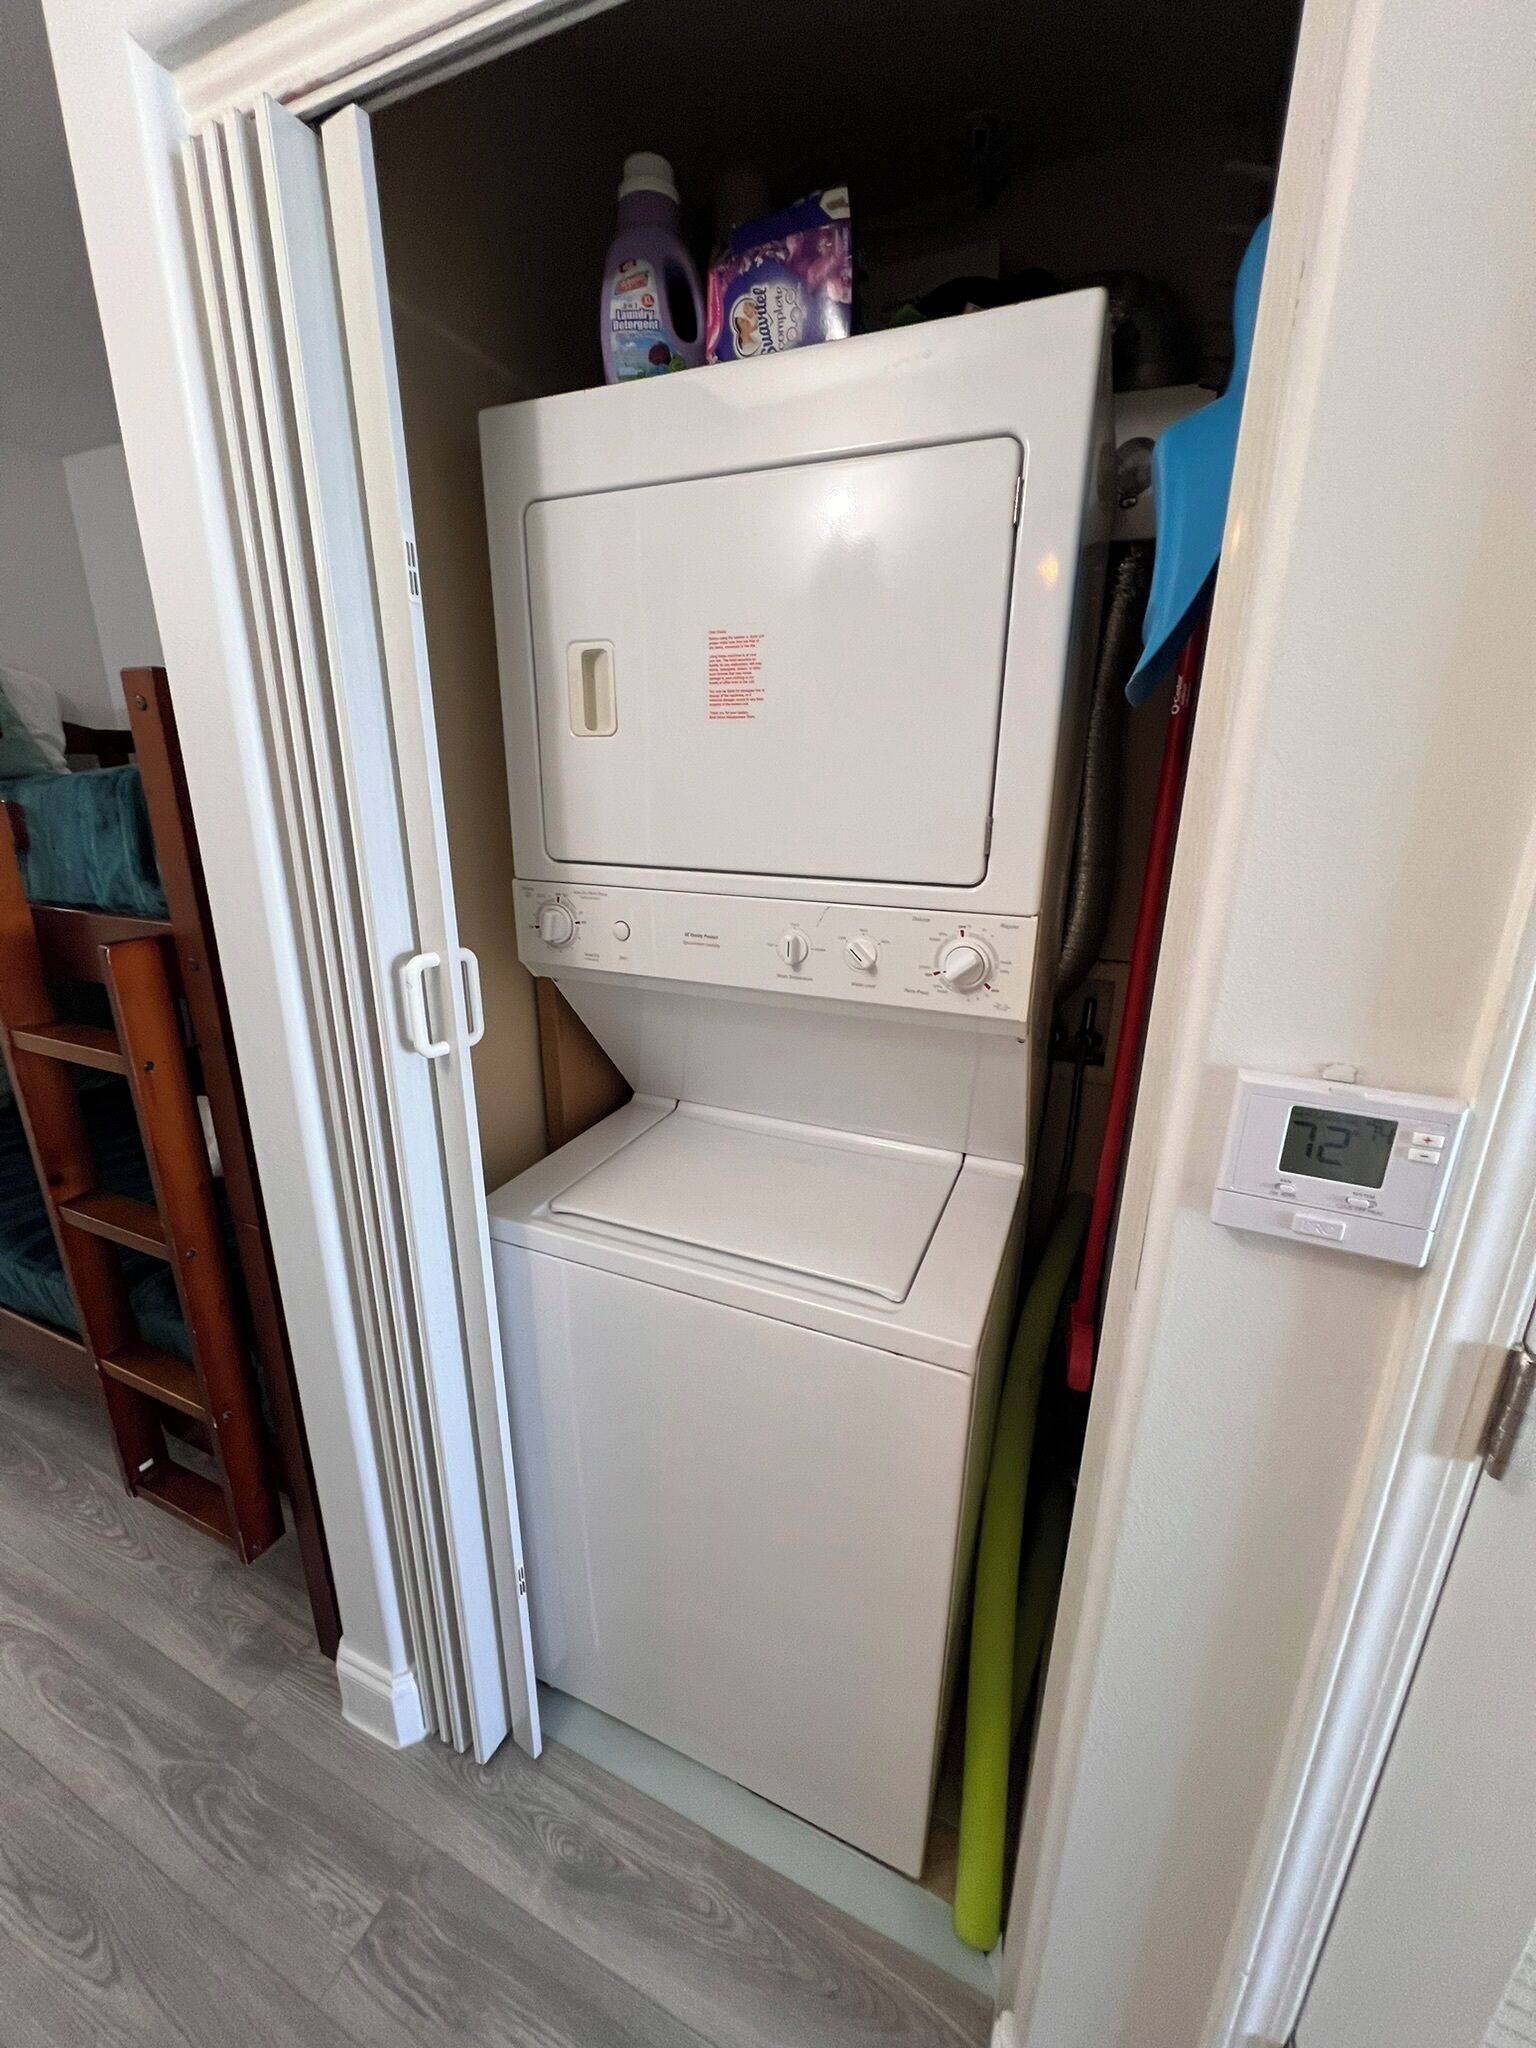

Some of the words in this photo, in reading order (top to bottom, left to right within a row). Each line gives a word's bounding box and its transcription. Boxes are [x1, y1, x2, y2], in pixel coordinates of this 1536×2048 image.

[615, 309, 654, 321] Laundry
[612, 319, 660, 332] Detergent
[1292, 1120, 1351, 1167] 72
